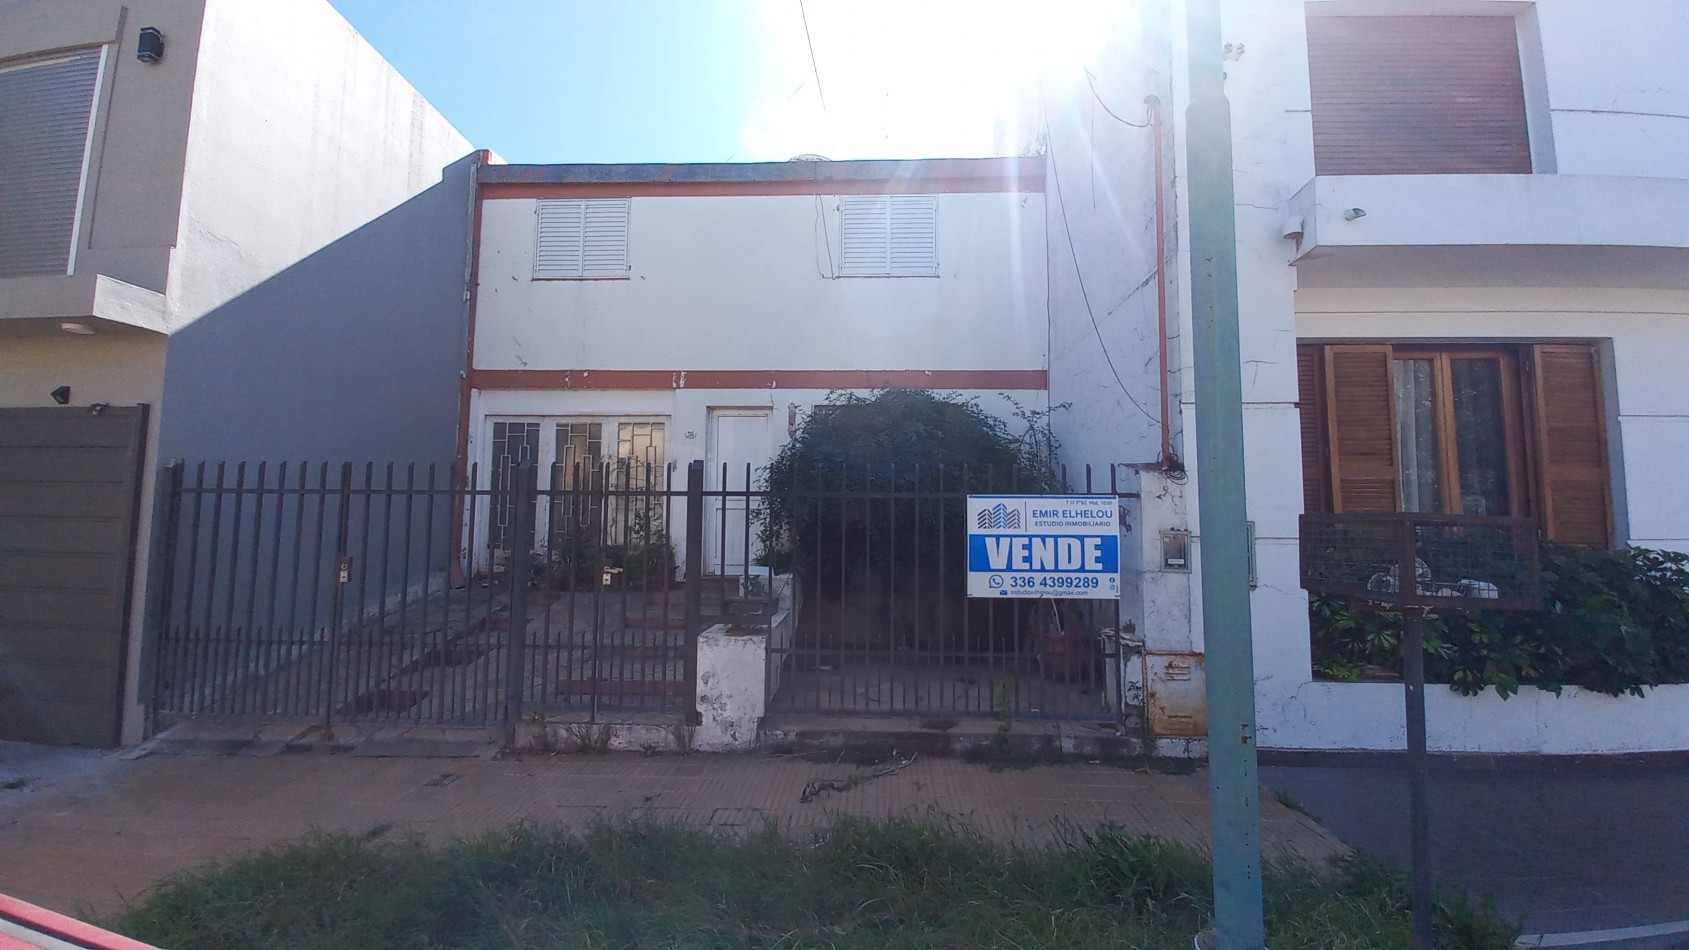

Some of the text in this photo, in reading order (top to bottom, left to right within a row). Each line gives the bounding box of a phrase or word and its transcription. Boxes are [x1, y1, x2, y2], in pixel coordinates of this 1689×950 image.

[1032, 510, 1113, 518] EMIR ELHELOU
[985, 537, 1103, 570] VENDE
[1010, 576, 1099, 588] 336 4399289
